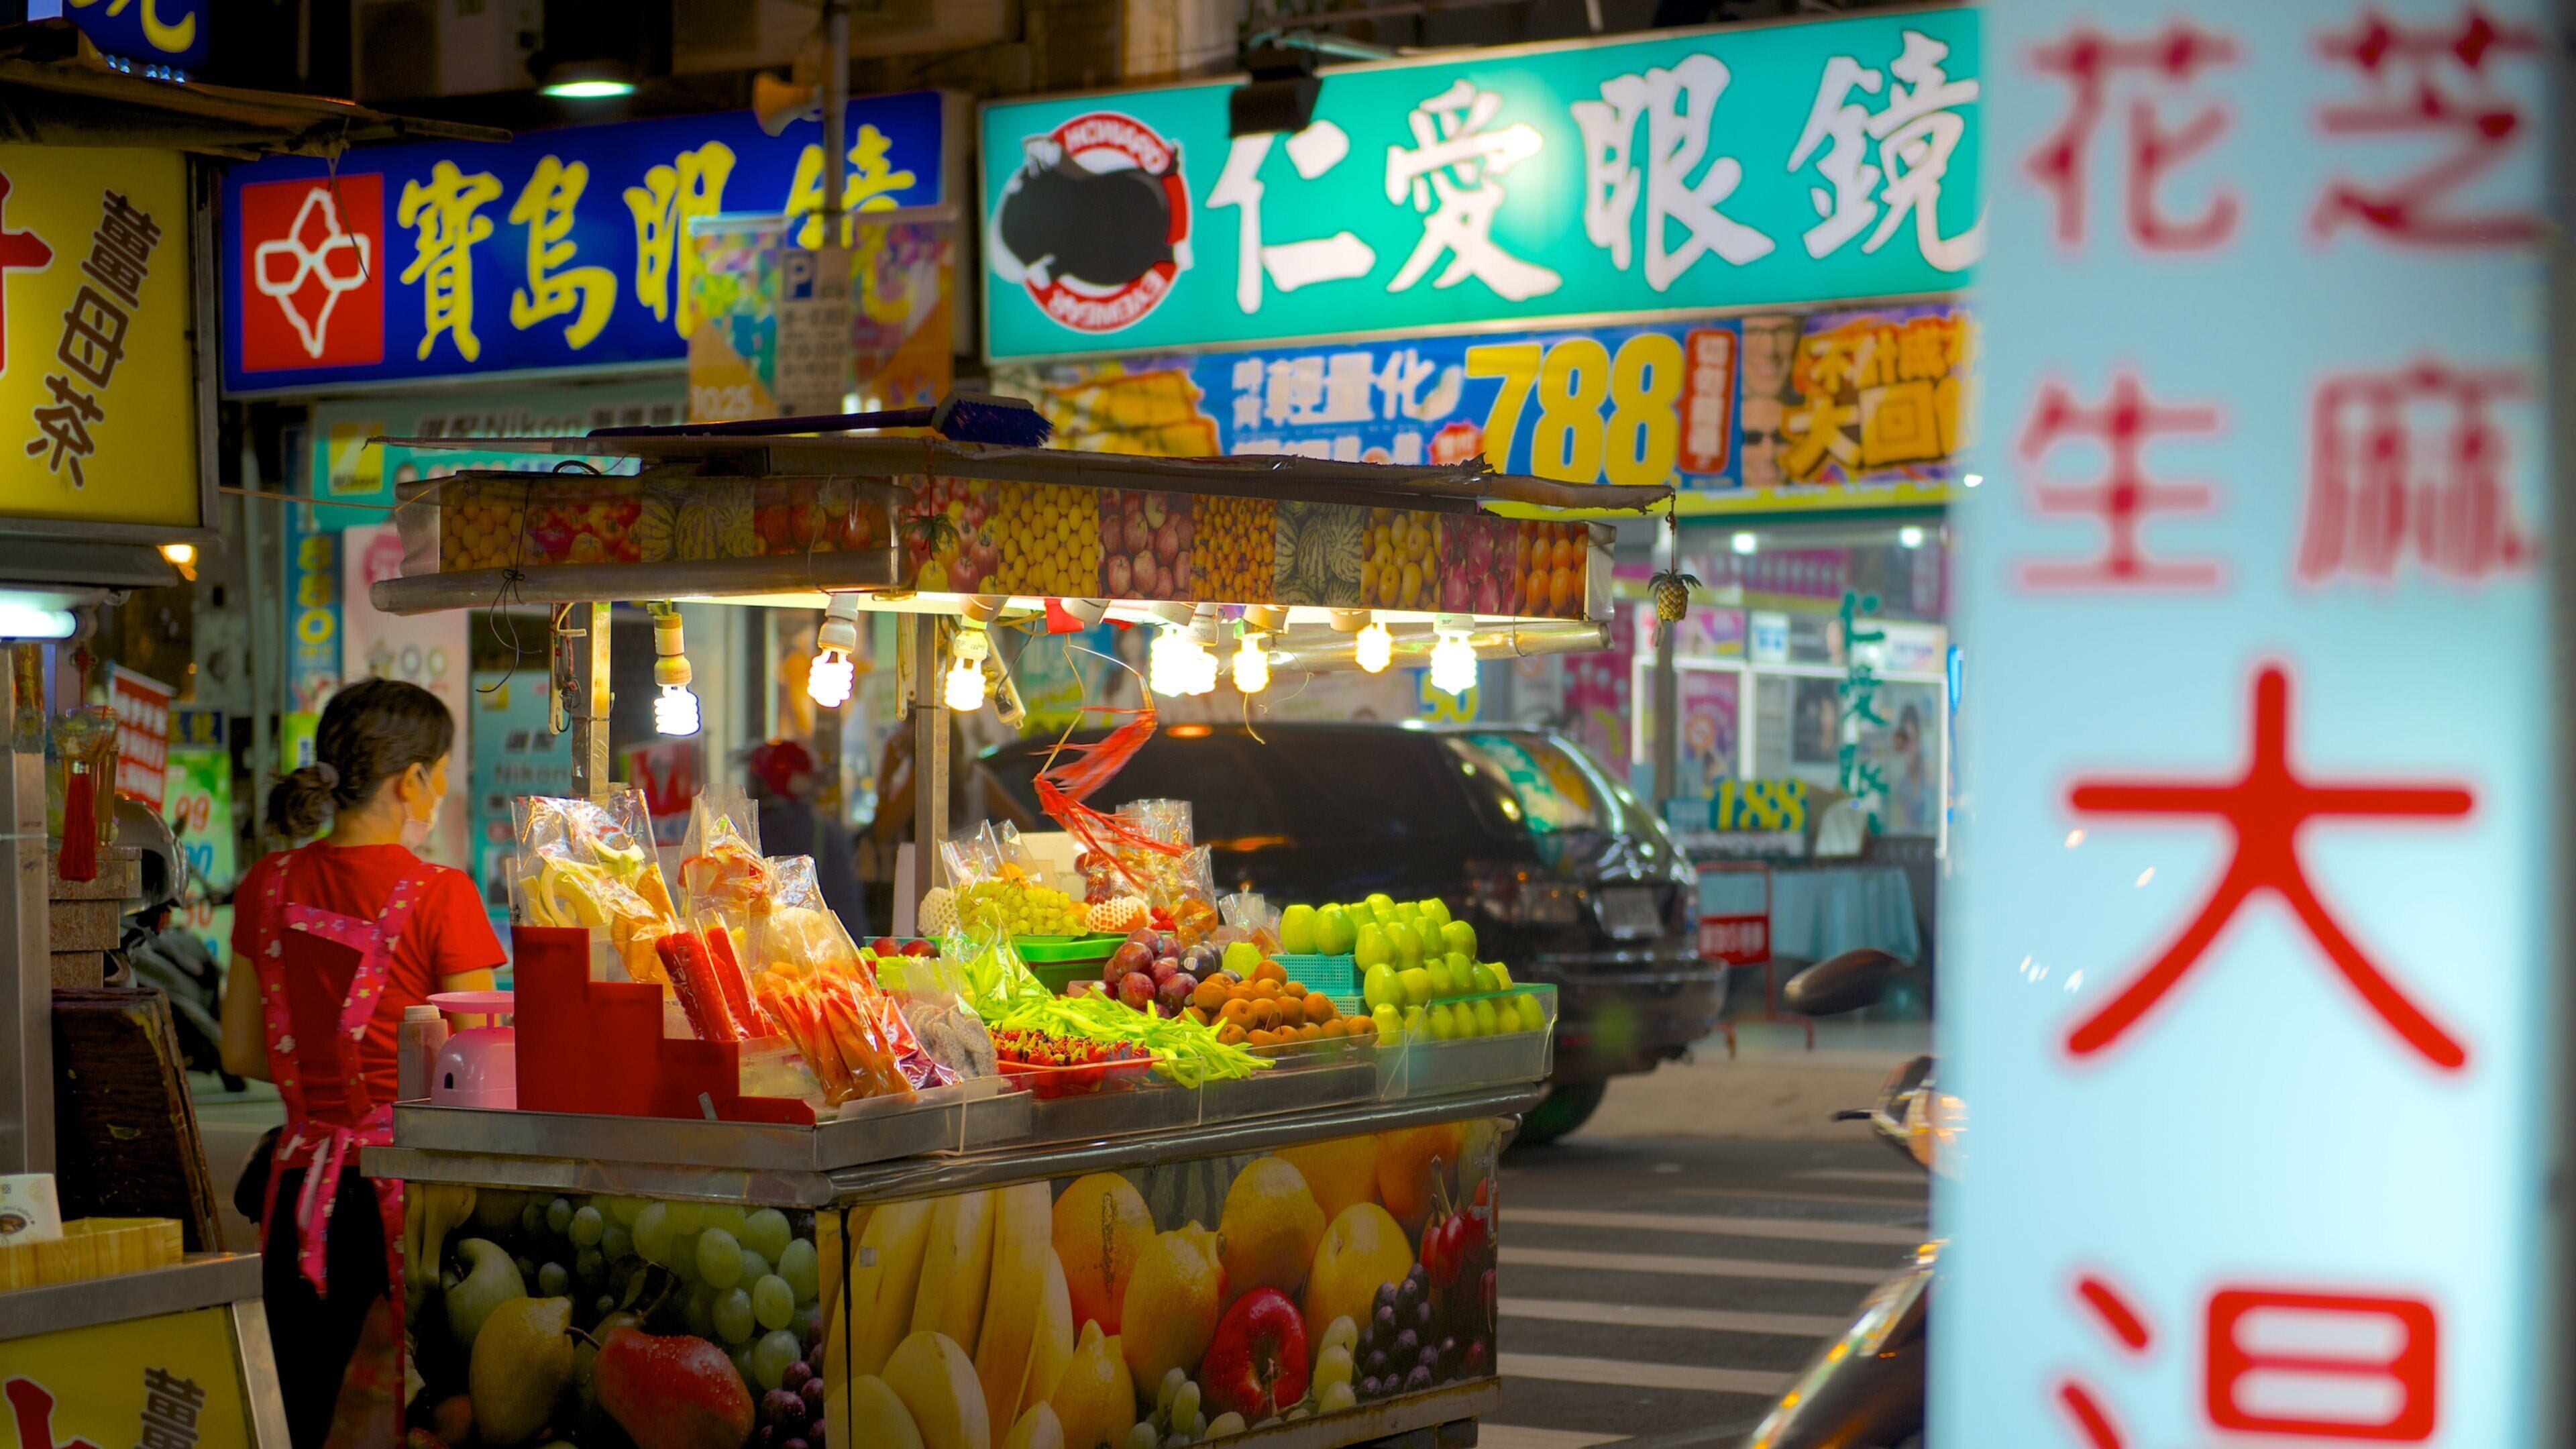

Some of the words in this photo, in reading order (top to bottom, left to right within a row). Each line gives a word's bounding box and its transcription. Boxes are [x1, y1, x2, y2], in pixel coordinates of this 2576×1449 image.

[396, 124, 916, 363] 寶島眼鏡
[1205, 30, 1987, 314] 仁愛眼鏡
[2023, 20, 2244, 594] 花生
[2294, 13, 2549, 587] 芝麻
[25, 189, 162, 488] 薑母茶
[1464, 332, 1685, 485] 788
